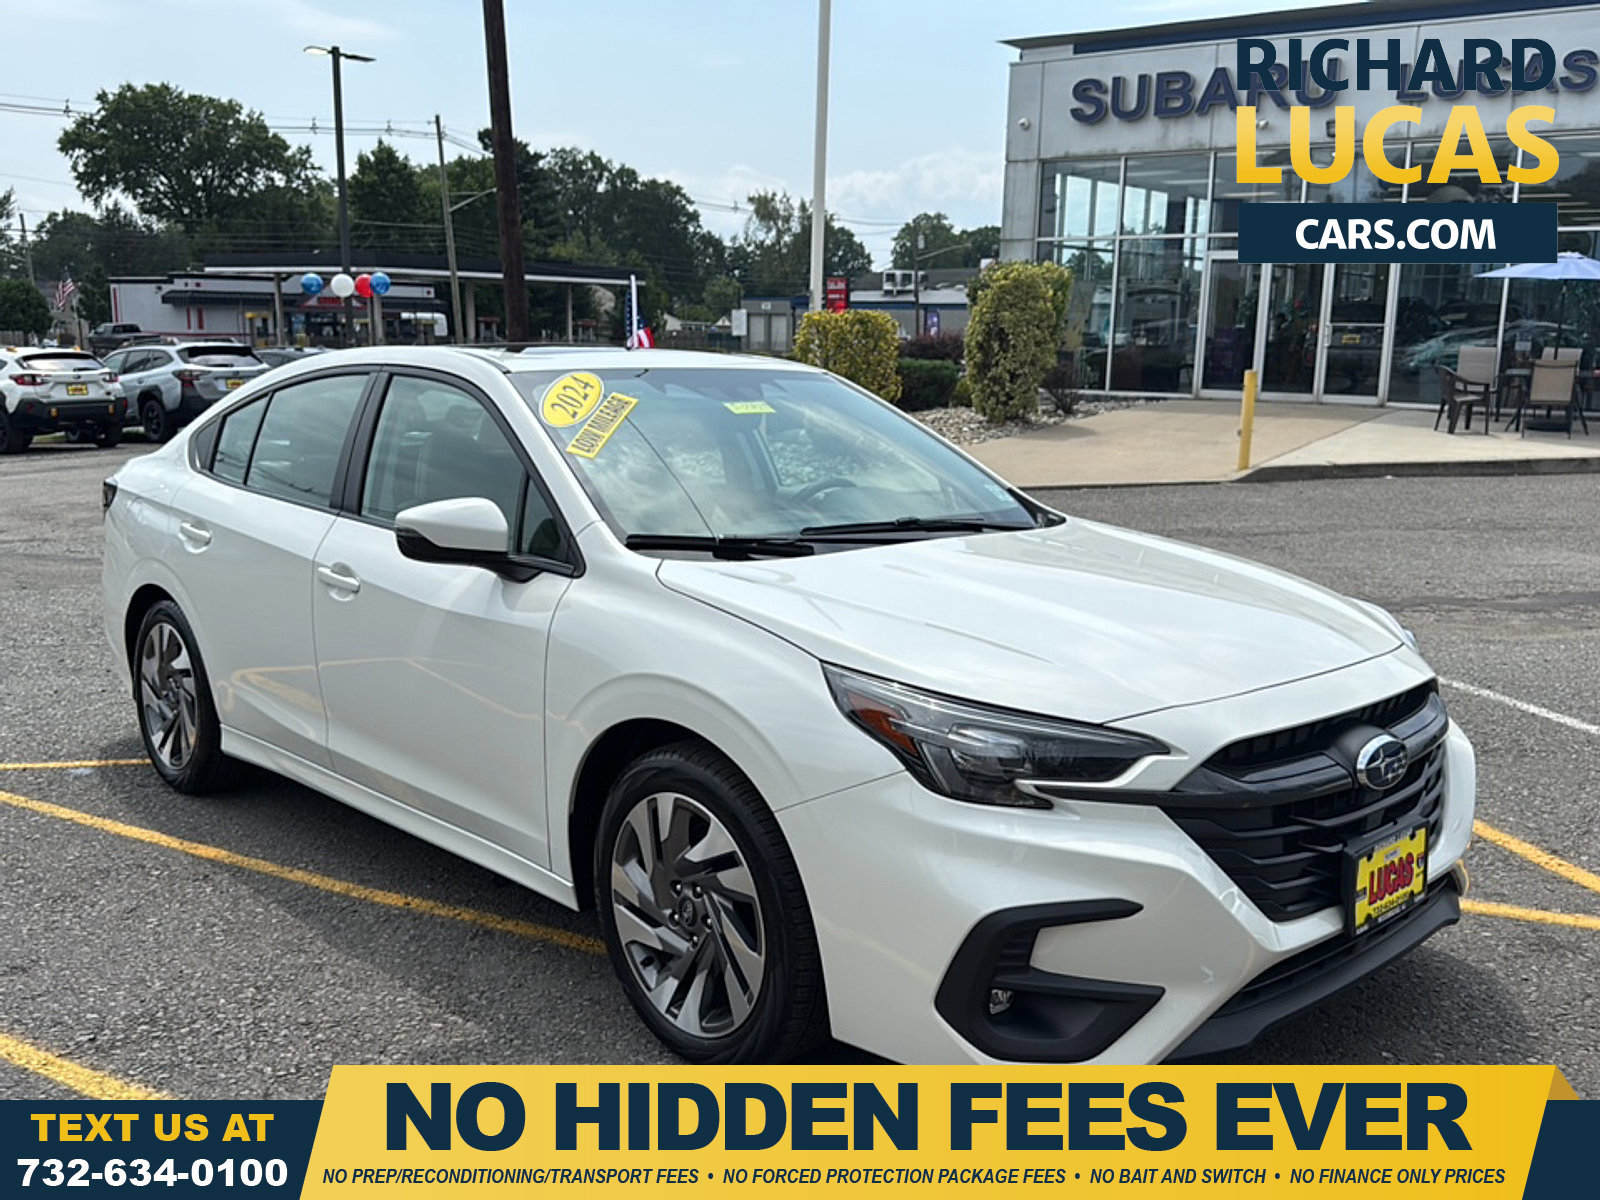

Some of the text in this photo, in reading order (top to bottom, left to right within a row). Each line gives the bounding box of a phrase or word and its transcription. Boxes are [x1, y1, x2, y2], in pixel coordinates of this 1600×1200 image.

[1070, 55, 1343, 126] SUBARU
[550, 374, 596, 420] 2024
[569, 394, 633, 455] LOW MILEAGE
[1368, 852, 1415, 906] LUCAS
